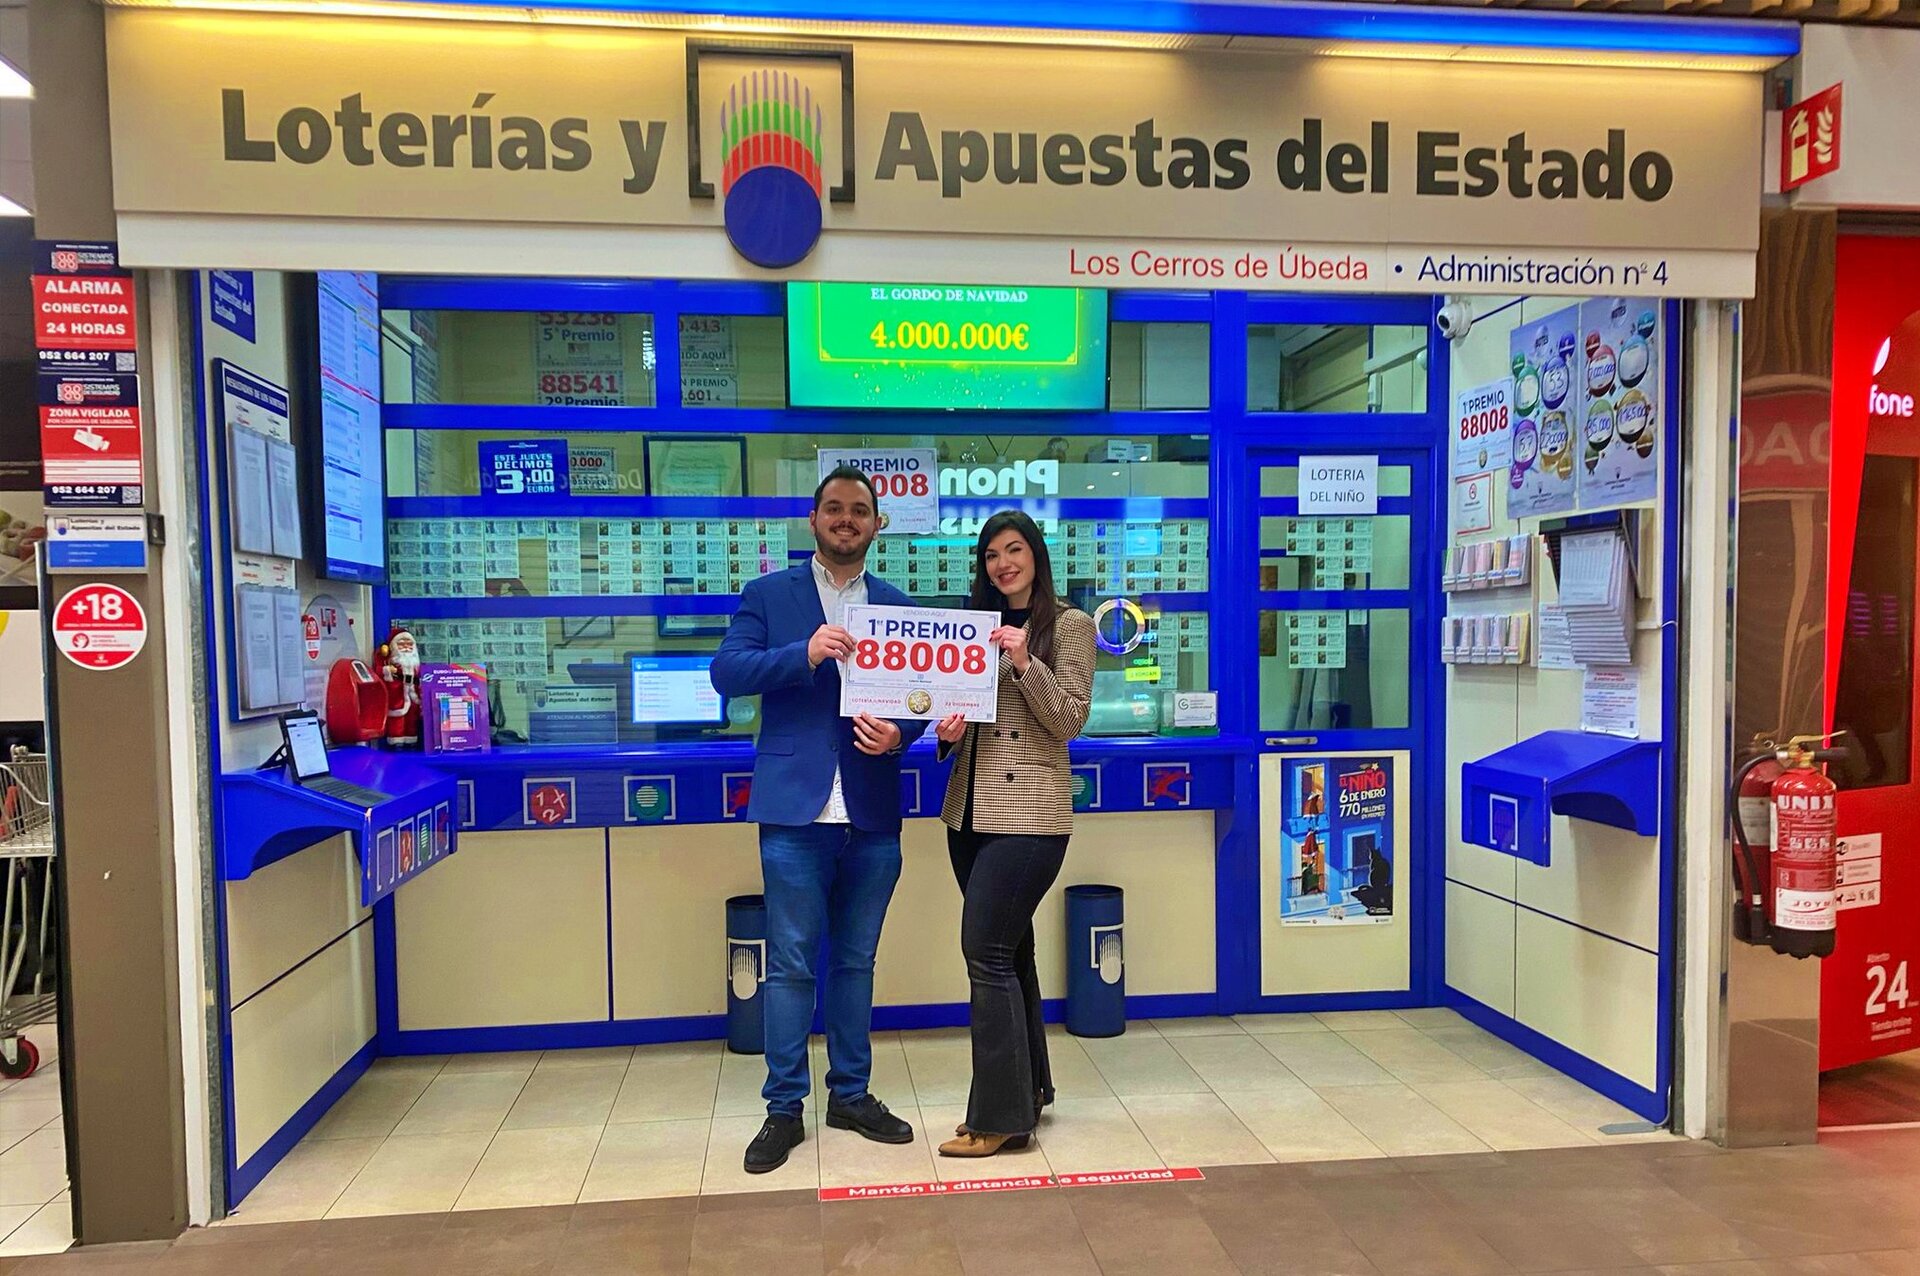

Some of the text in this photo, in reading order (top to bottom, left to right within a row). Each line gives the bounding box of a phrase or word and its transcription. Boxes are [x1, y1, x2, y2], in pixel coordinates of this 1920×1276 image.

[221, 87, 1674, 202] Loterías y Apuestas del Estado
[1069, 246, 1369, 282] Los Cerros de Úbeda
[1418, 255, 1617, 287] Administración
[1651, 260, 1669, 286] 4
[44, 280, 124, 295] ALARMA
[870, 288, 1029, 303] EL GORDO DE NAVIDAD
[41, 302, 129, 315] CONECTADA
[46, 322, 126, 335] 24 HORAS
[561, 328, 616, 342] Premio
[869, 319, 1030, 351] 4.000.000€
[39, 350, 111, 361] 952 664 207
[541, 374, 619, 394] 88541
[690, 378, 729, 387] PREMIO
[565, 395, 619, 406] Premio
[1469, 390, 1505, 413] PREMIO
[1868, 384, 1915, 417] fone
[49, 408, 131, 418] ZONA VIGILADA
[1460, 404, 1509, 441] 88008
[494, 453, 553, 462] ESTE JUEVES
[850, 457, 921, 472] PREMIO
[1311, 468, 1366, 482] LOTERIA
[51, 486, 117, 495] 952 664 207
[527, 484, 556, 494] EUROS
[1309, 488, 1366, 503] DEL NIÑO
[71, 593, 124, 621] +18
[885, 619, 977, 641] PREMIO
[855, 638, 988, 676] 88008
[1349, 768, 1387, 793] NIÑO
[1339, 787, 1387, 804] 6 DE ENERO
[1339, 802, 1361, 818] 770
[1865, 960, 1910, 1016] 24
[848, 1183, 924, 1197] Mantén
[930, 1181, 948, 1192] la
[953, 1176, 1042, 1192] distancia
[1076, 1169, 1175, 1184] seguridad
